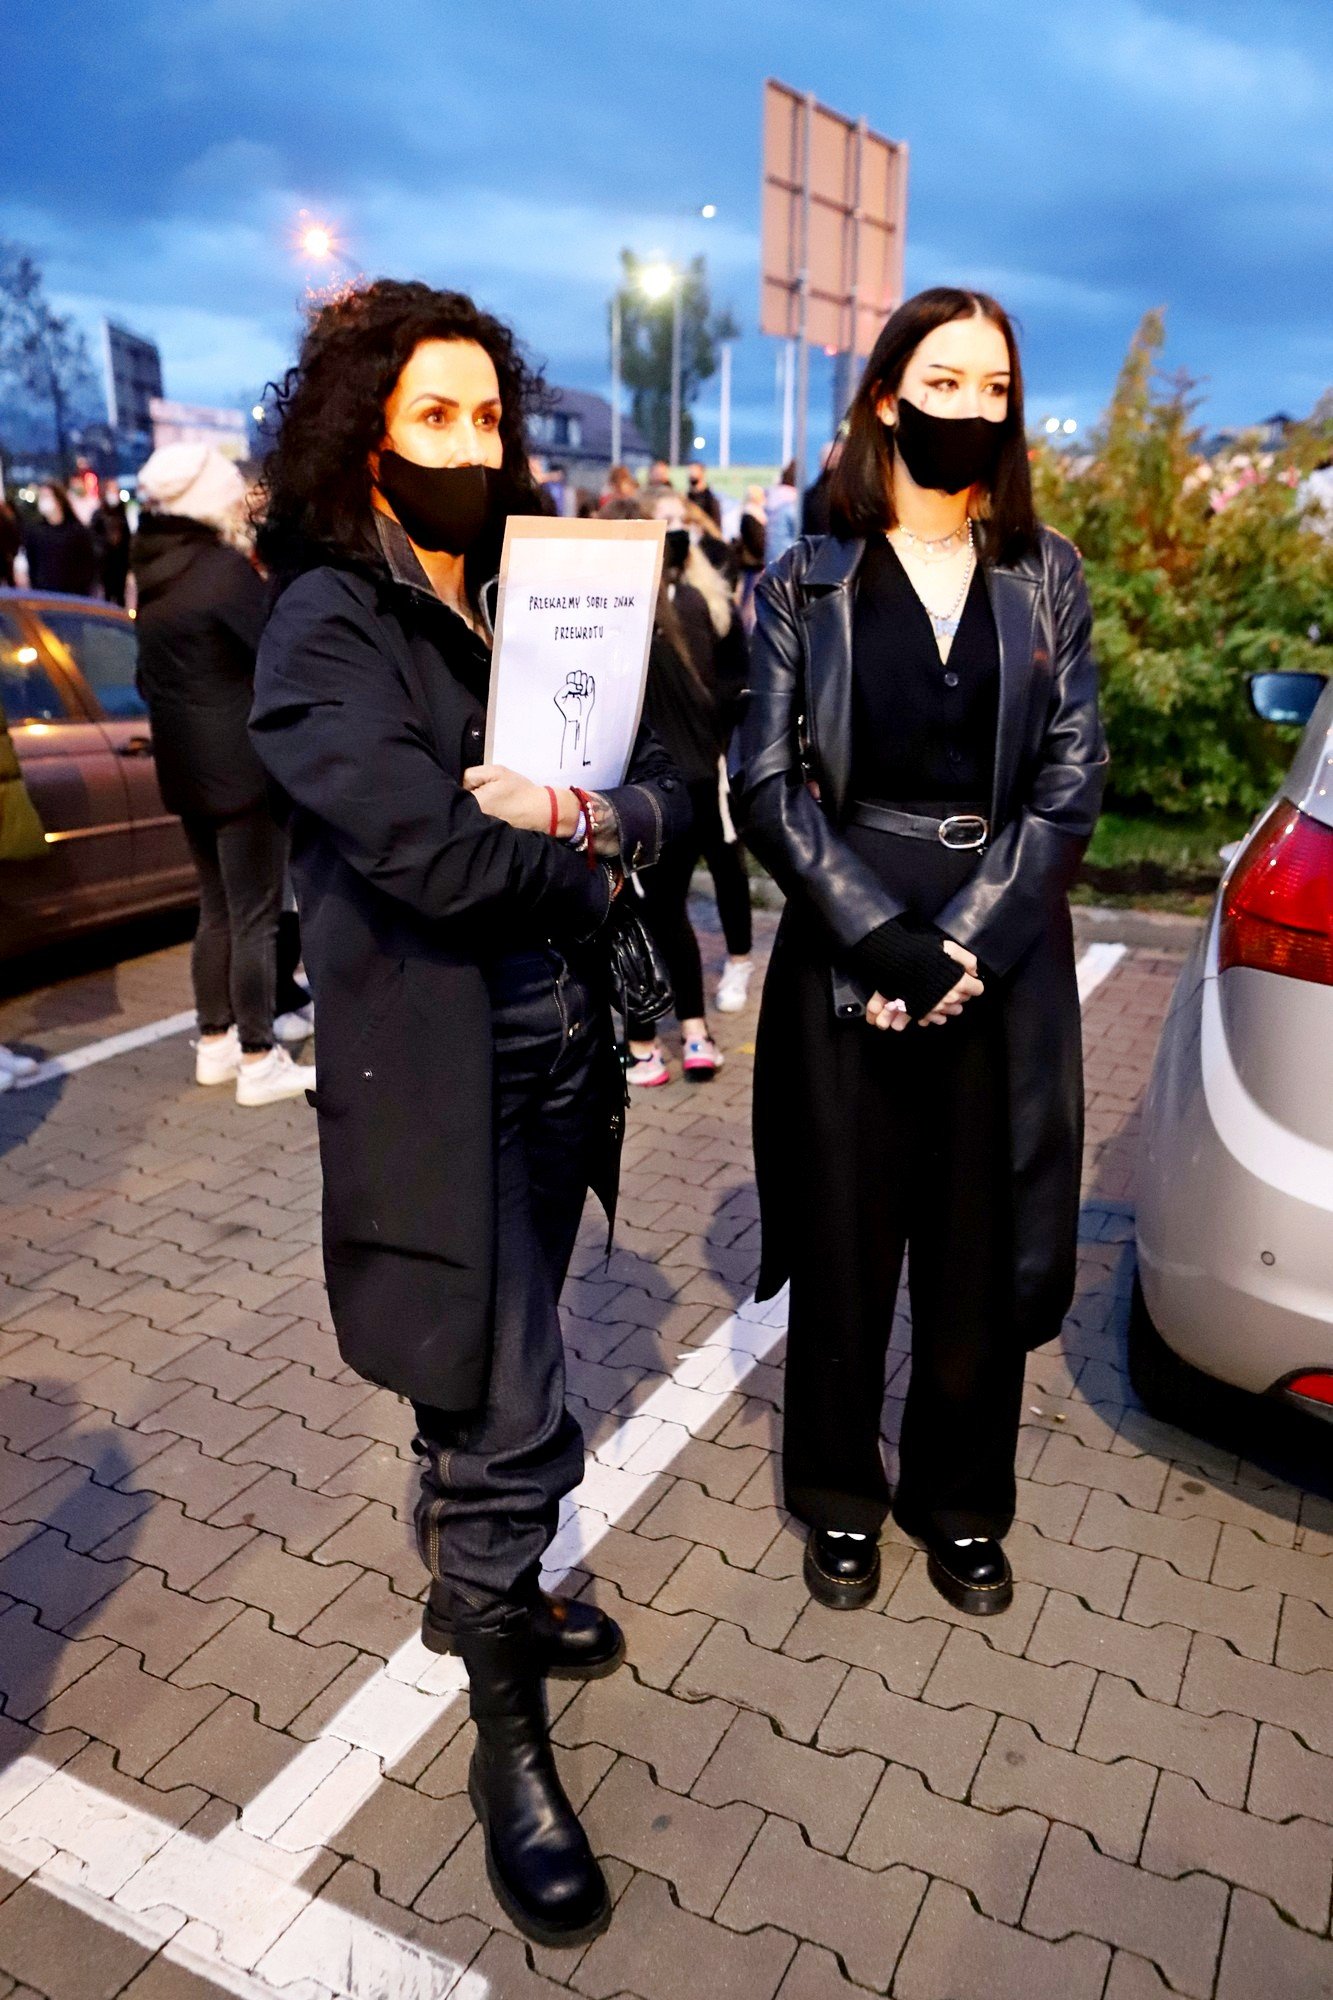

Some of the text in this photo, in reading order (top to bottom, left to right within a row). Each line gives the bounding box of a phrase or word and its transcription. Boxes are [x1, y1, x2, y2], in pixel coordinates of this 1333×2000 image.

[586, 595, 608, 609] SOBIE
[613, 596, 635, 609] ZNAK
[554, 625, 604, 641] PRZEWROTU
